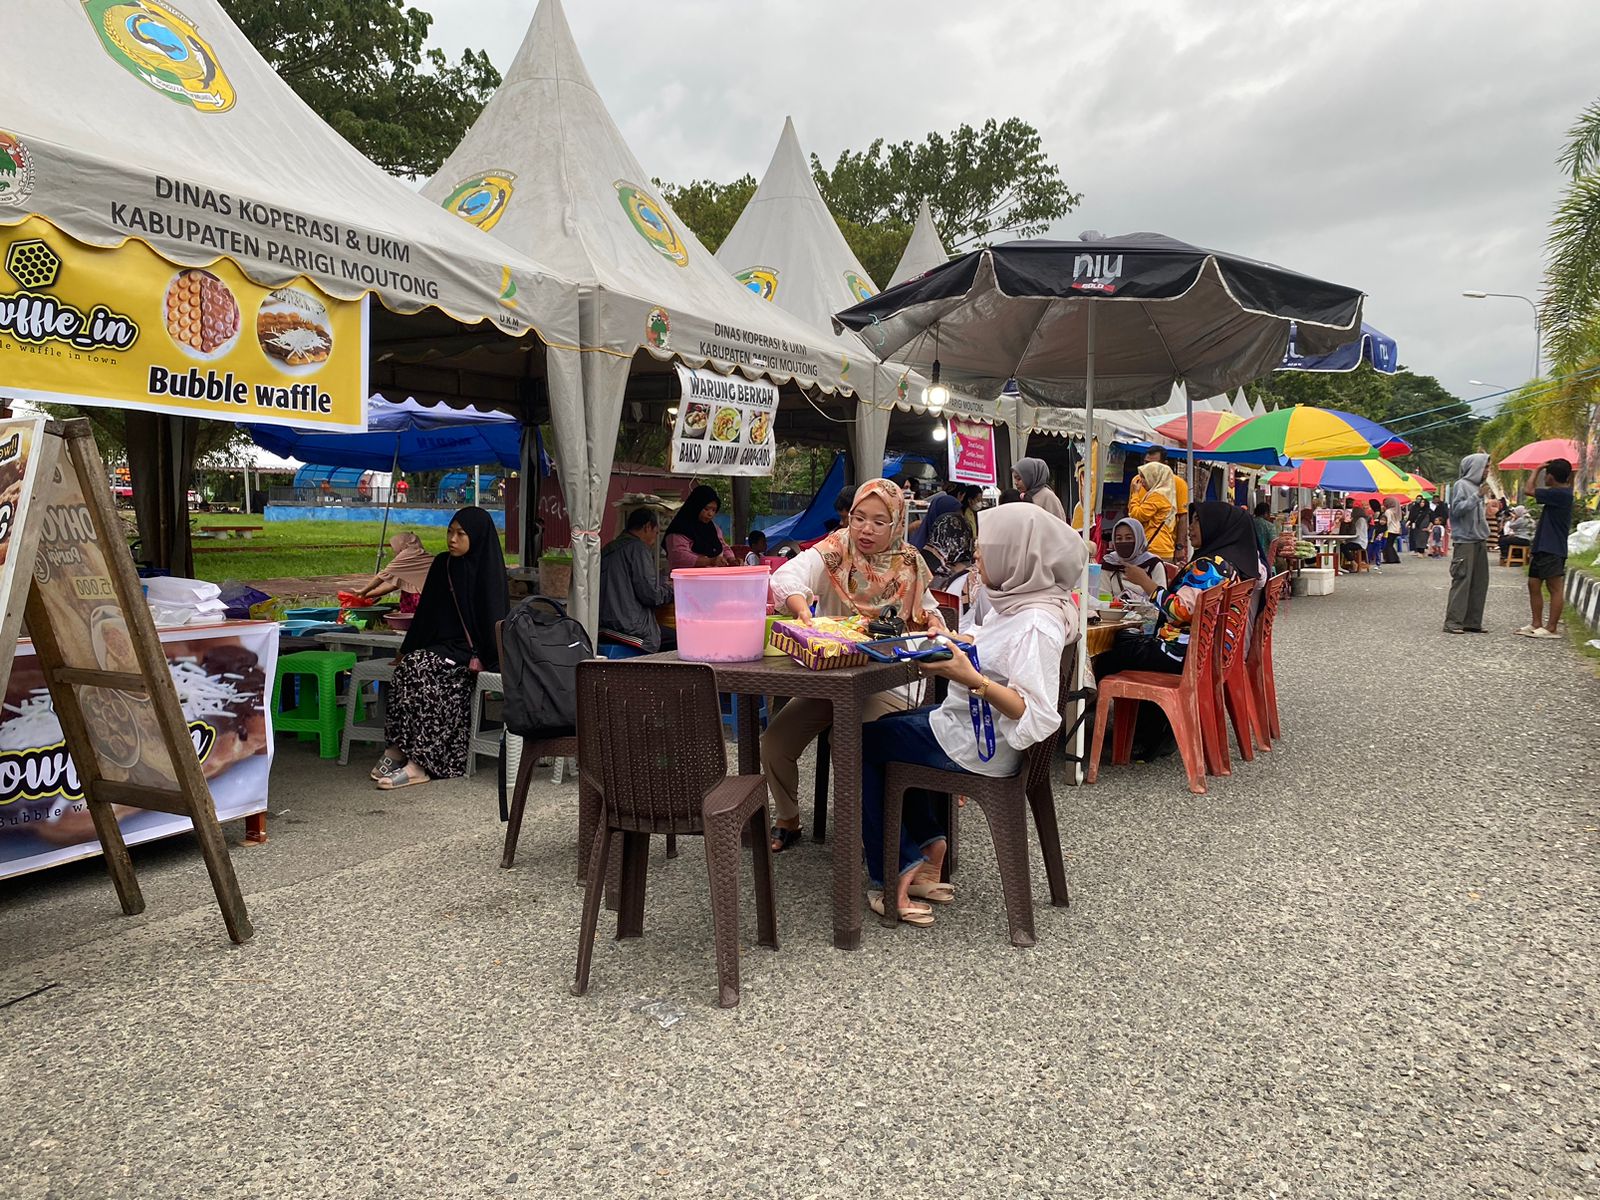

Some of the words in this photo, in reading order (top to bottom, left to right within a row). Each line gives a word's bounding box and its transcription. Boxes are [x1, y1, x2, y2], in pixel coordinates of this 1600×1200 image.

[156, 175, 232, 215] DINAS
[239, 199, 339, 245] KOPERASI
[346, 229, 361, 251] &
[367, 235, 410, 263] UKM
[111, 201, 260, 258] KABUPATEN
[267, 241, 336, 276] PARIGI
[341, 259, 439, 299] MOUTONG
[500, 313, 519, 327] UKM
[714, 323, 741, 341] DINAS
[742, 330, 781, 350] KOPERASI
[782, 340, 789, 352] &
[789, 342, 807, 356] UKM
[20, 345, 62, 356] waffle
[68, 350, 81, 360] in
[88, 354, 117, 365] town
[699, 341, 751, 364] KABUPATEN
[779, 358, 818, 377] MOUTONG
[149, 366, 248, 404] Bubble
[255, 383, 331, 413] waffle
[690, 377, 736, 400] WARUNG
[737, 384, 774, 405] BERKAH
[679, 443, 702, 463] BAKSO
[706, 445, 724, 464] SOTO
